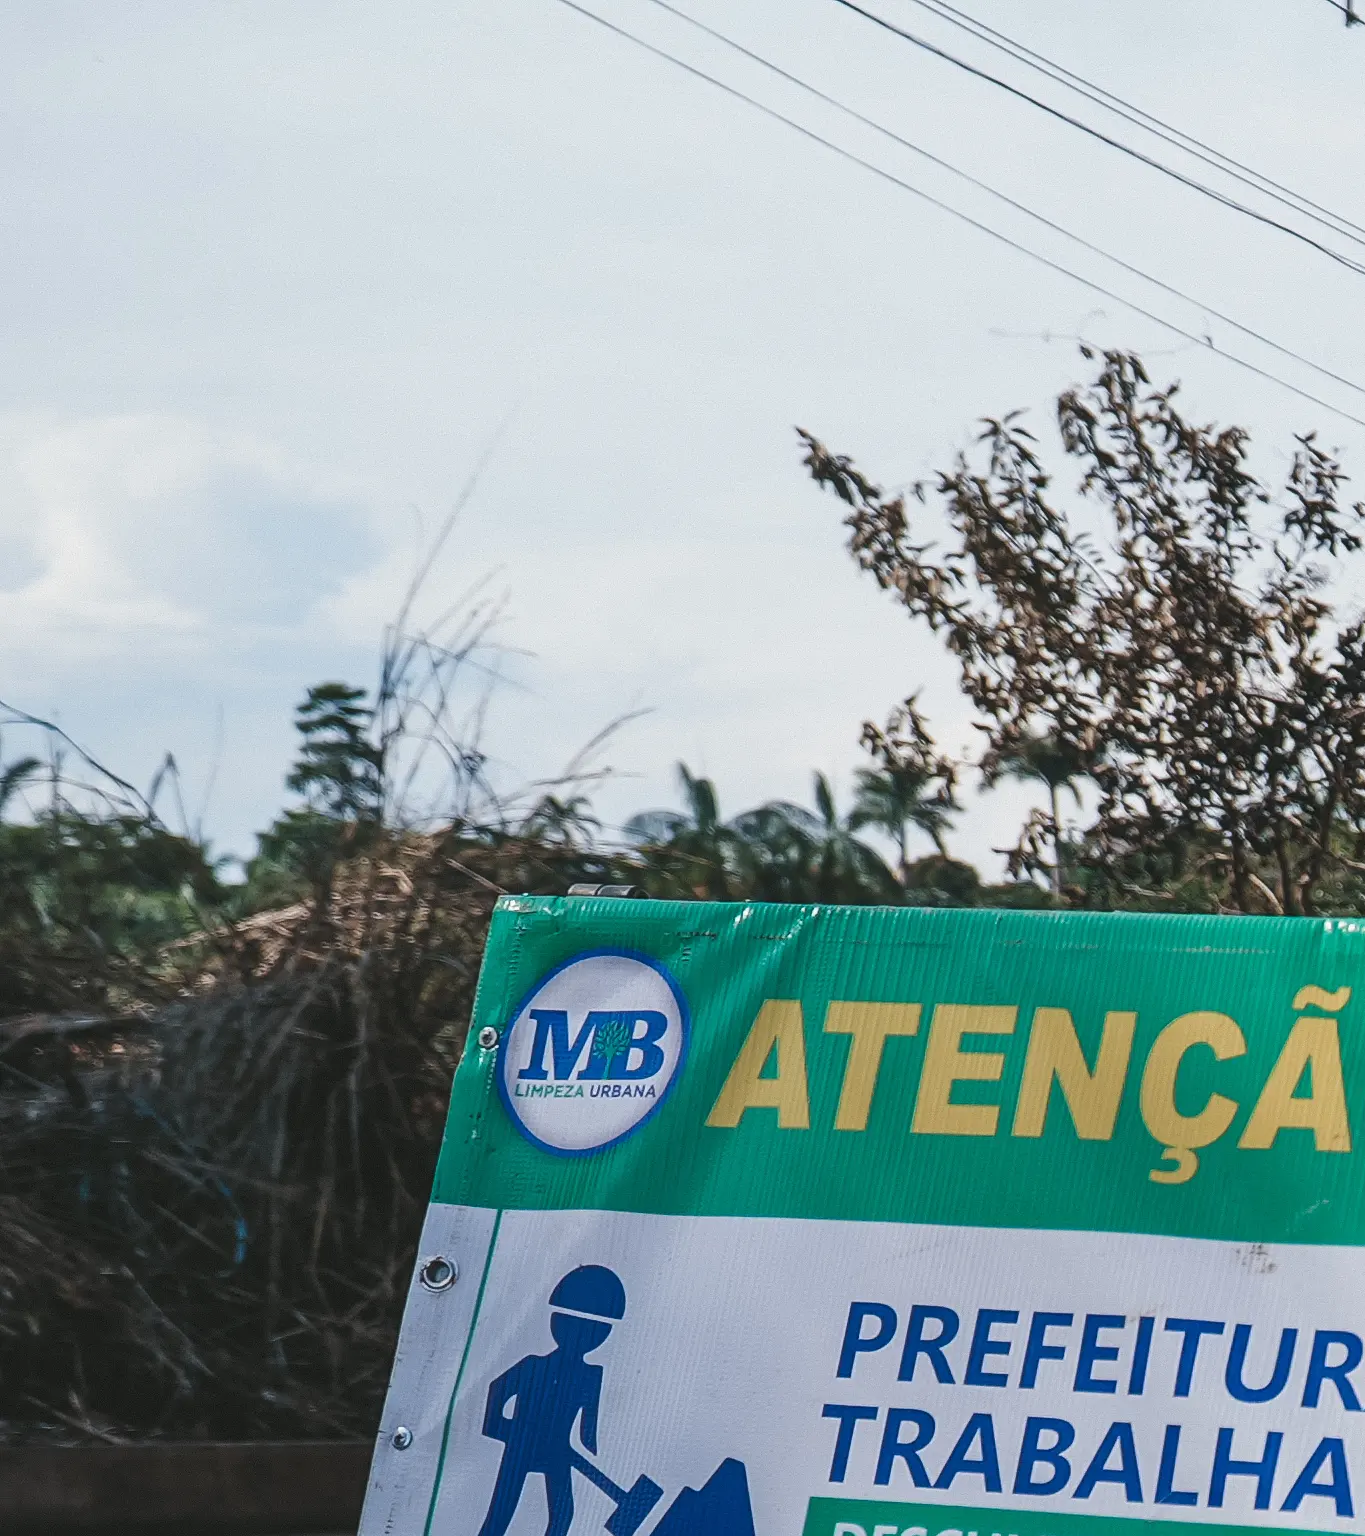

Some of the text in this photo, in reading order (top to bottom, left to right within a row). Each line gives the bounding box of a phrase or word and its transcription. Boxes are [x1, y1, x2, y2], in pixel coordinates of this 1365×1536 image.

[518, 1009, 668, 1081] MB
[514, 1083, 657, 1099] LIMPEZA URBANA
